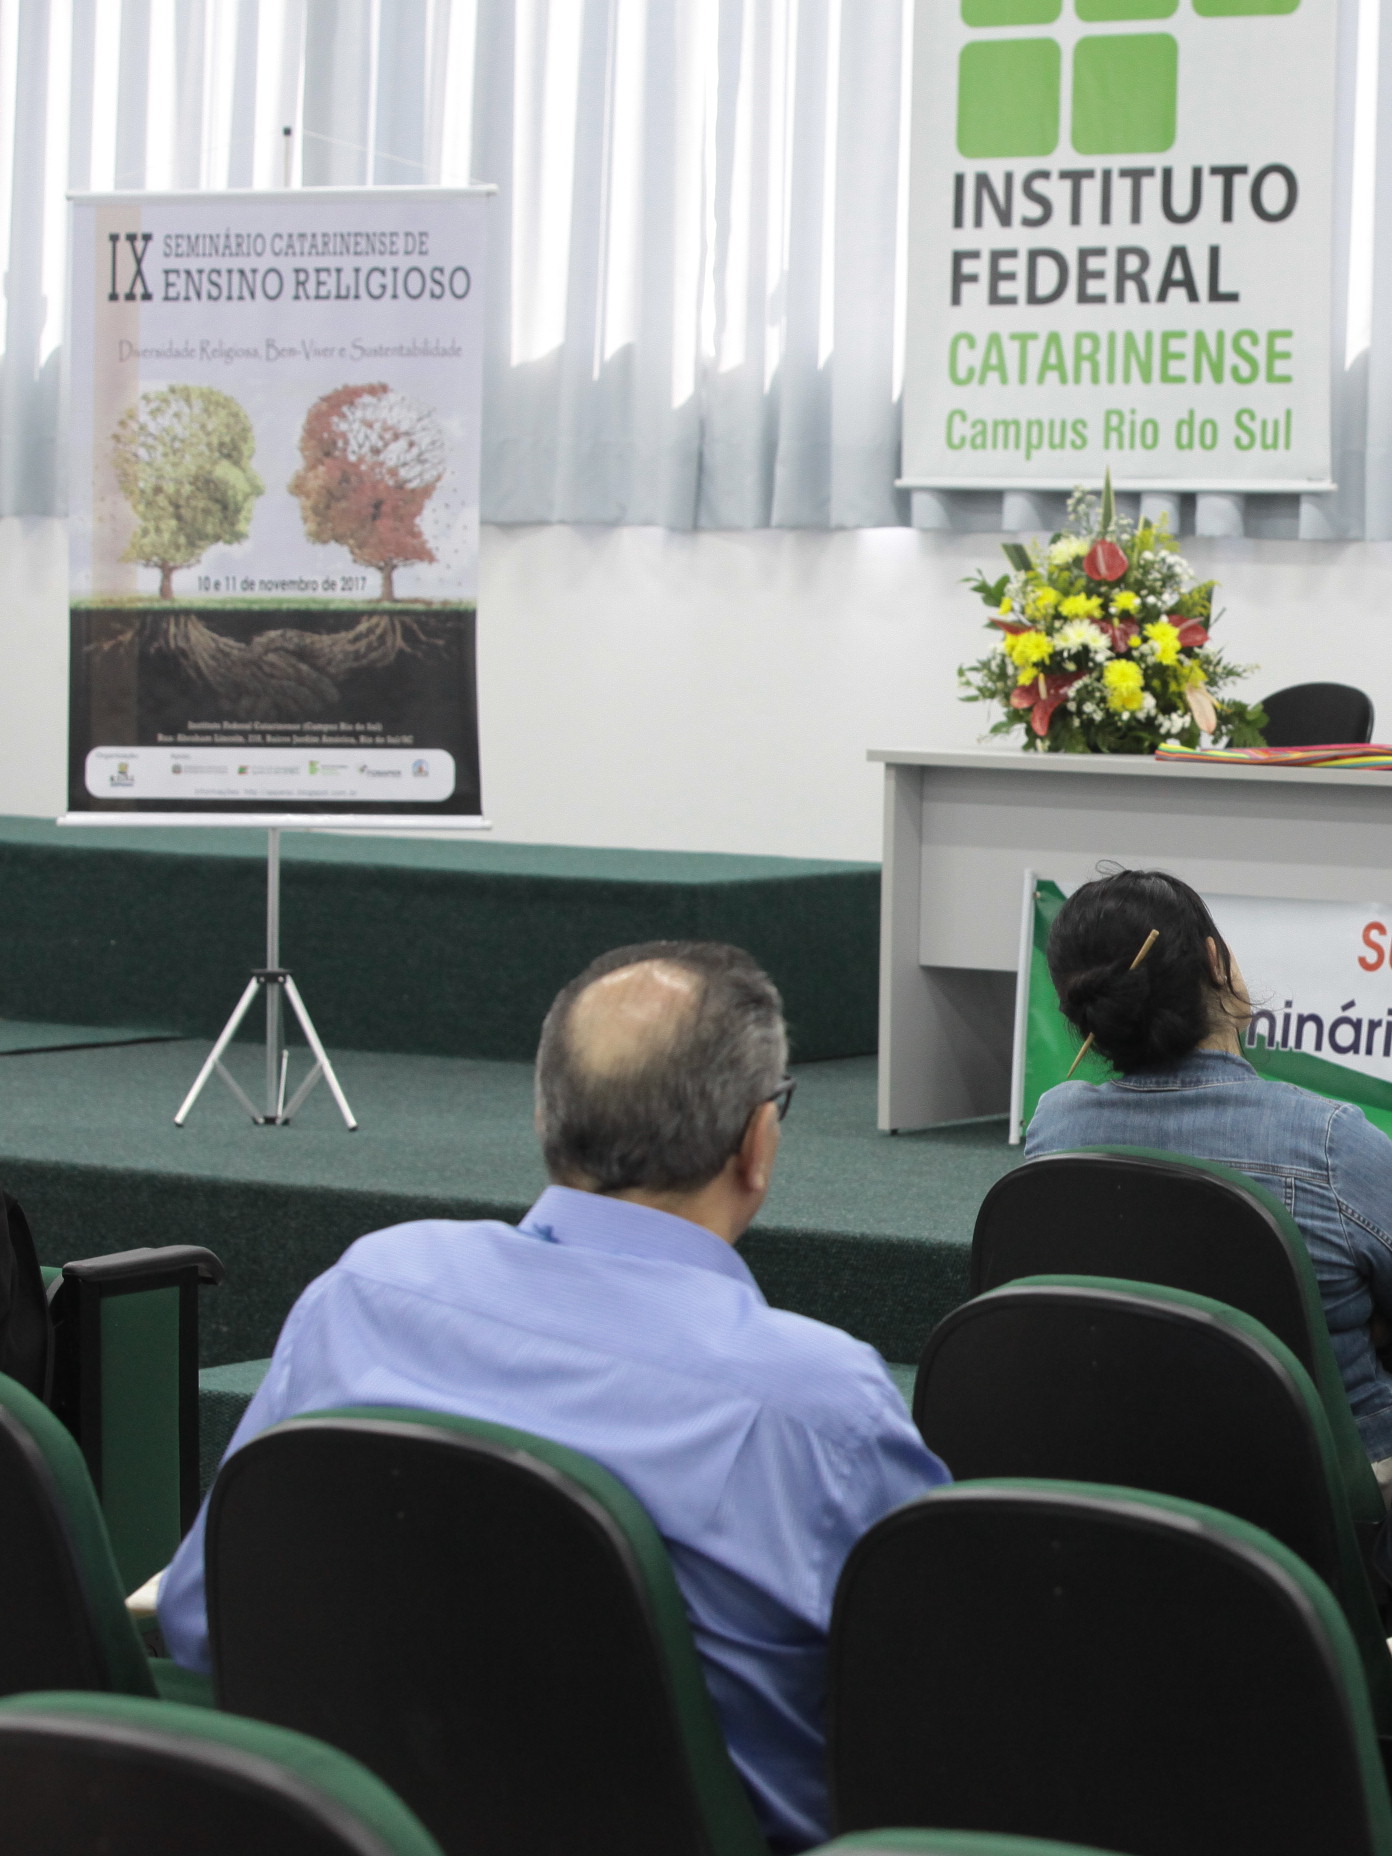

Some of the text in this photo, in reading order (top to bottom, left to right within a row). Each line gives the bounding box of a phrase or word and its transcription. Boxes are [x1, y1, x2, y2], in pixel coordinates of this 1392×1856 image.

[951, 163, 1298, 229] INSTITUTO
[108, 233, 153, 302] IX
[162, 228, 430, 258] SEMINÁRIO CATARINENSE DE
[162, 266, 472, 302] ENSINO RELIGIOSO
[950, 243, 1240, 307] FEDERAL
[948, 329, 1294, 387] CATARINENSE
[945, 407, 1293, 461] Campus Rio do Sul
[197, 576, 366, 592] 10 e 11 de novembro de 2017
